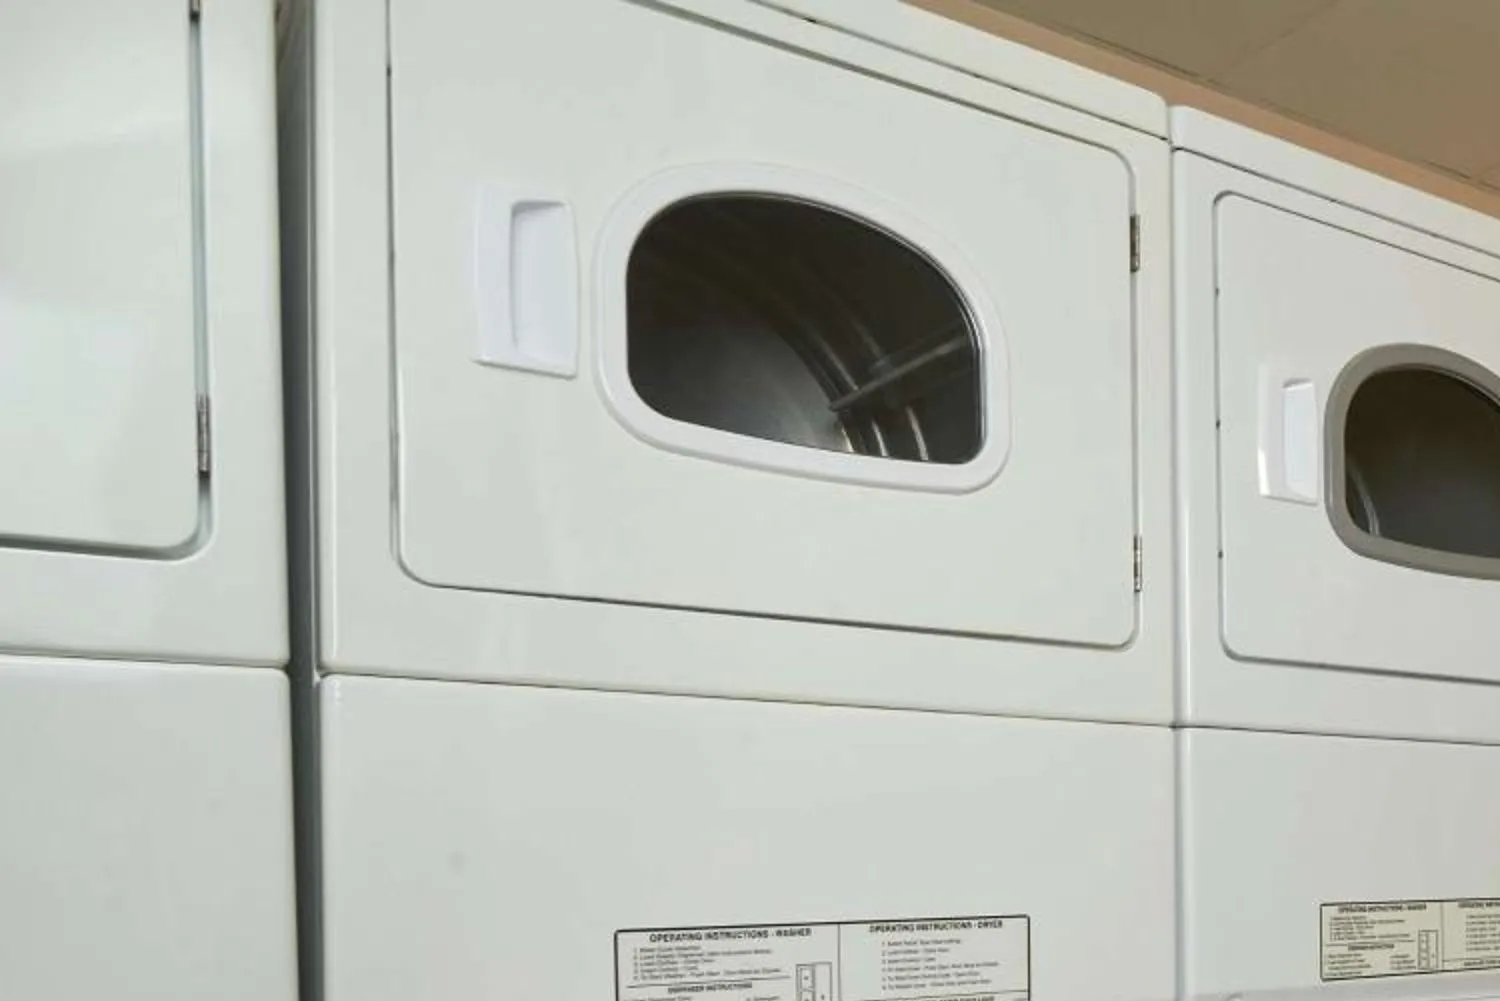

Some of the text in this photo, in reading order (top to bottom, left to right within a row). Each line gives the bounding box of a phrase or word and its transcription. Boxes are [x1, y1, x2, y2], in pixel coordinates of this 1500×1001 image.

[869, 923, 914, 934] OPERATING
[916, 921, 972, 932] INSTRUCTIONS
[650, 933, 702, 943] OPERATING
[704, 929, 769, 941] INSTRUCTIONS
[776, 928, 811, 938] WASHER
